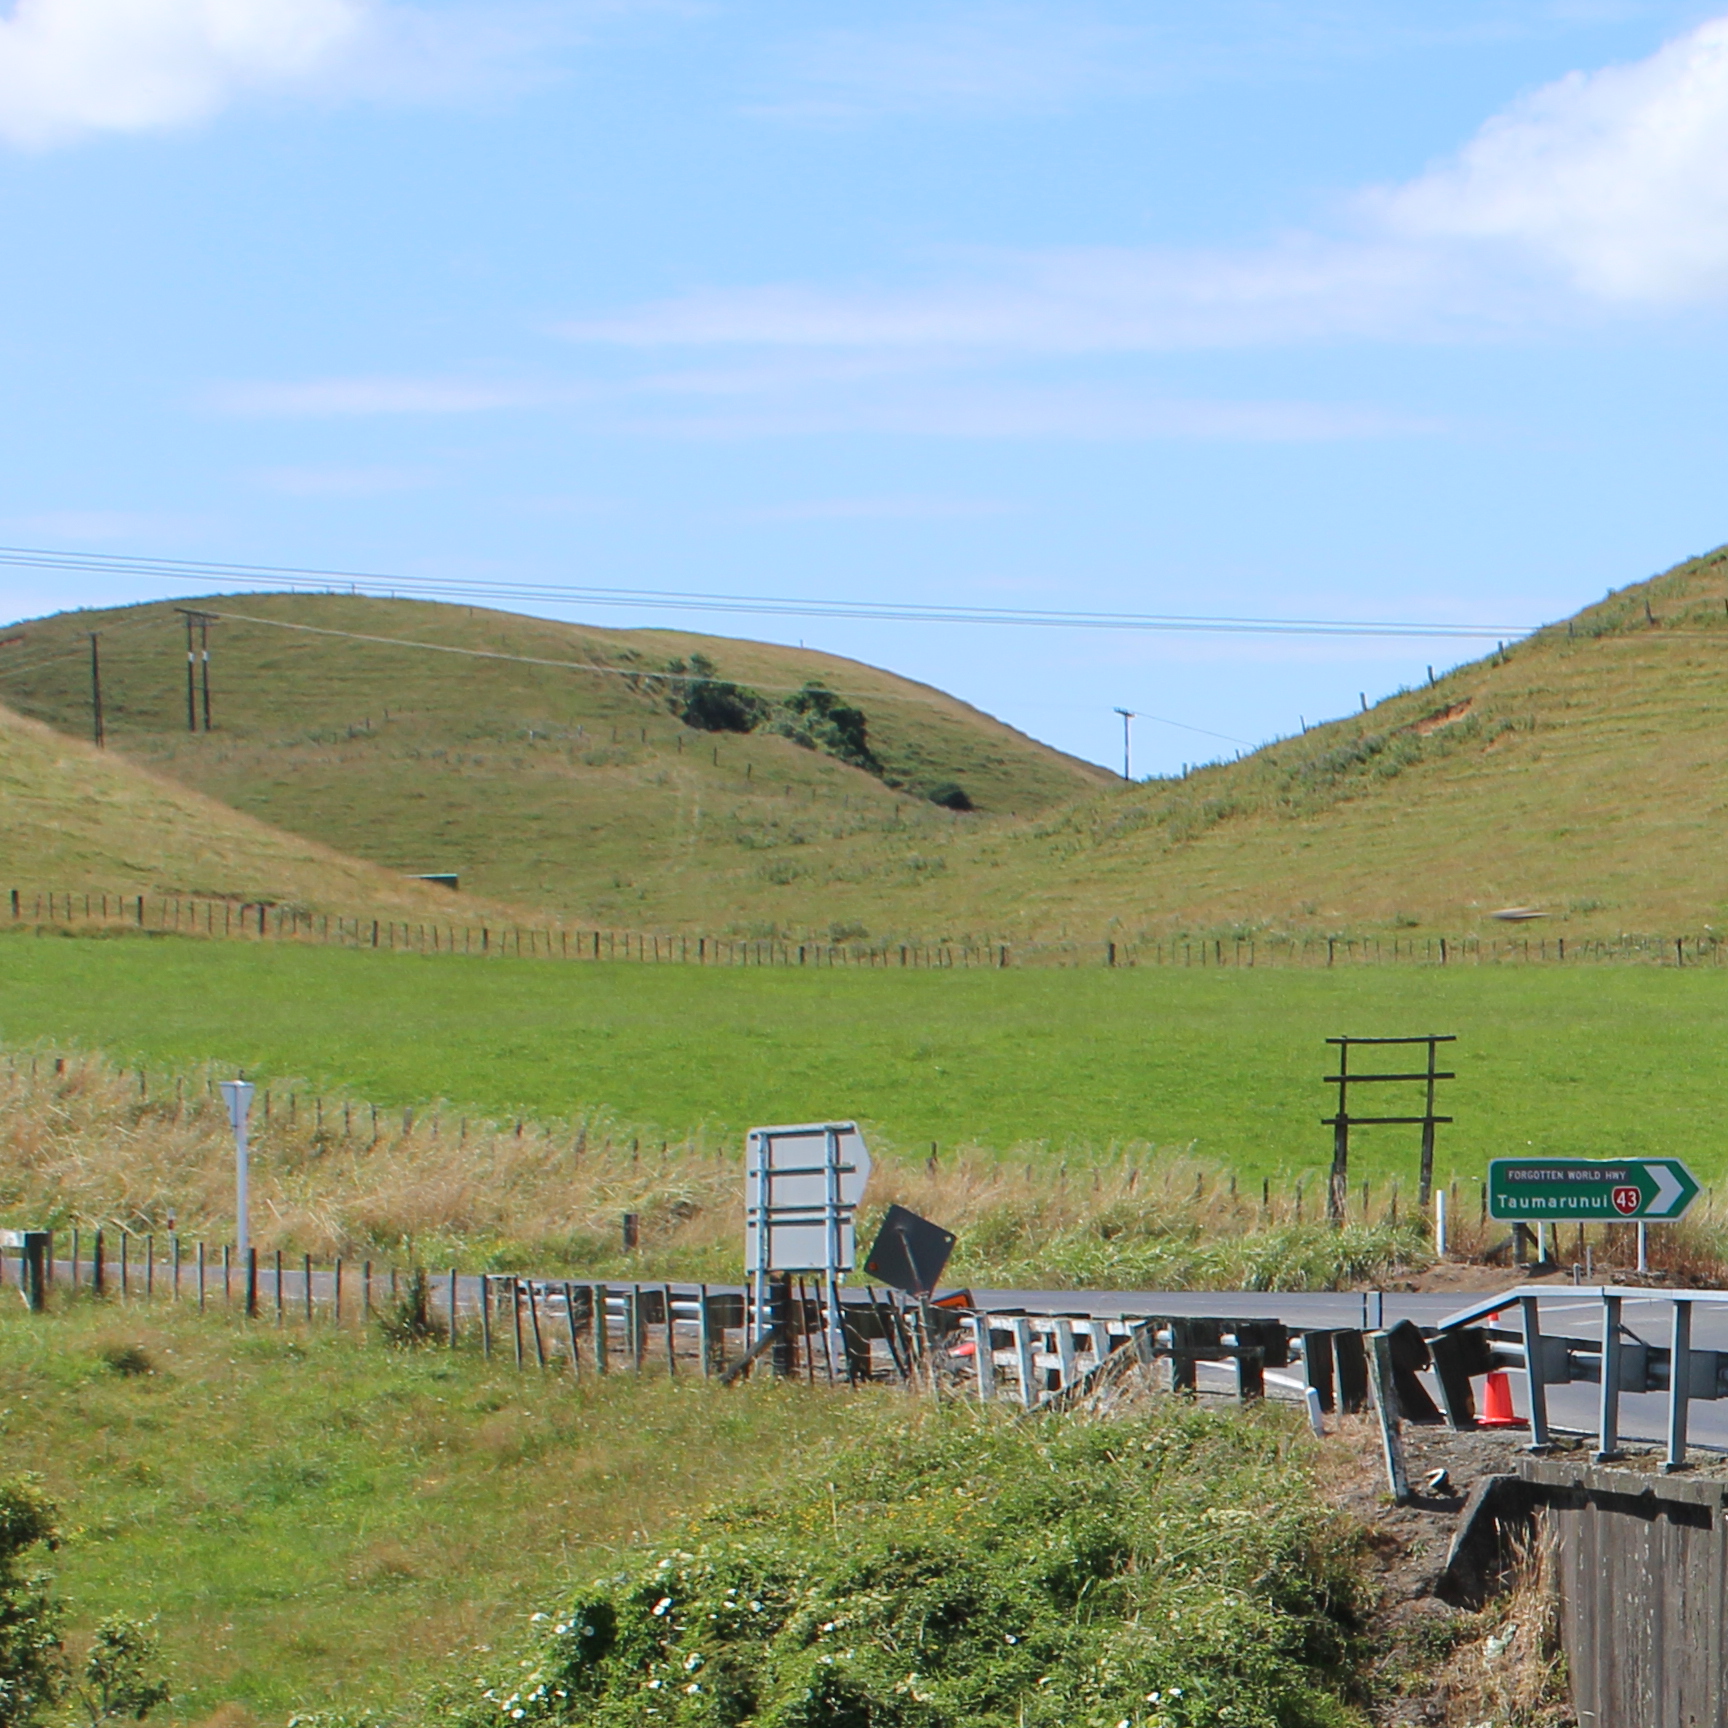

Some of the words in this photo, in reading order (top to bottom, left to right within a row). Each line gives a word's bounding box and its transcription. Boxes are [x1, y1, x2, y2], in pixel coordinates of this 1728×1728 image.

[1508, 1169, 1564, 1181] FORGOTTEN
[1567, 1169, 1601, 1181] WORLD
[1605, 1169, 1627, 1181] HWY
[1497, 1194, 1608, 1209] Taumarunui
[1615, 1190, 1638, 1208] 43
